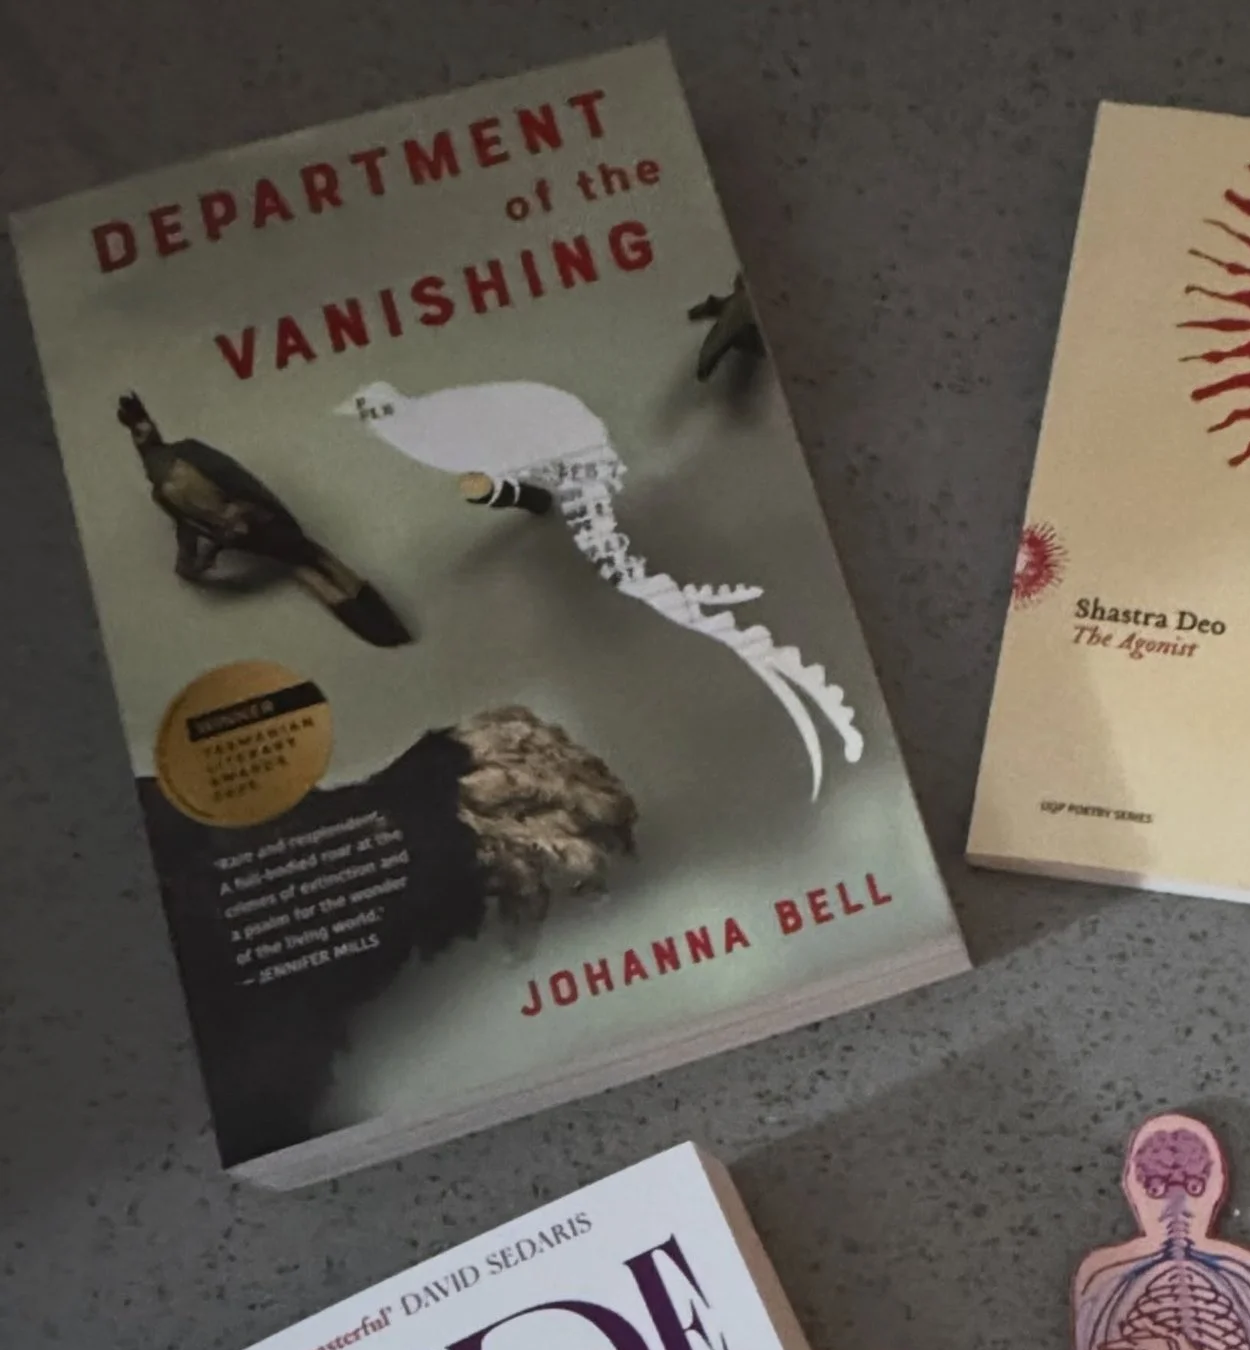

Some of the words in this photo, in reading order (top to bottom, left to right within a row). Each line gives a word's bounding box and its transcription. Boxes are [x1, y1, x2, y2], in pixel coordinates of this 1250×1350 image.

[93, 88, 607, 275] DEPARTMENT
[505, 178, 554, 222] of
[577, 155, 662, 203] the
[214, 219, 656, 380] VANISHING
[1071, 622, 1115, 648] The
[1115, 630, 1202, 661] Agonist
[1073, 595, 1170, 630] Shastra
[1174, 608, 1228, 637] Deo
[1067, 802, 1113, 820] POETRY
[1113, 808, 1154, 824] SERIES
[220, 882, 232, 896] A
[234, 854, 319, 890] full-bodied
[321, 844, 352, 862] roar
[357, 838, 373, 852] at
[375, 829, 404, 845] the
[257, 838, 286, 859] and
[279, 884, 295, 902] of
[301, 862, 376, 895] extinction
[380, 849, 410, 869] and
[231, 930, 242, 942] a
[244, 914, 291, 941] psalm
[294, 904, 317, 921] for
[319, 895, 347, 913] the
[351, 876, 409, 904] wonder
[236, 949, 253, 965] of
[255, 942, 283, 959] the
[285, 926, 330, 950] living
[258, 950, 331, 986] JENNIFER
[333, 932, 380, 960] MILLS
[520, 916, 752, 1018] JOHANNA
[773, 871, 893, 936] BELL
[400, 1264, 481, 1319] DAVID
[485, 1210, 595, 1276] SEDARIS
